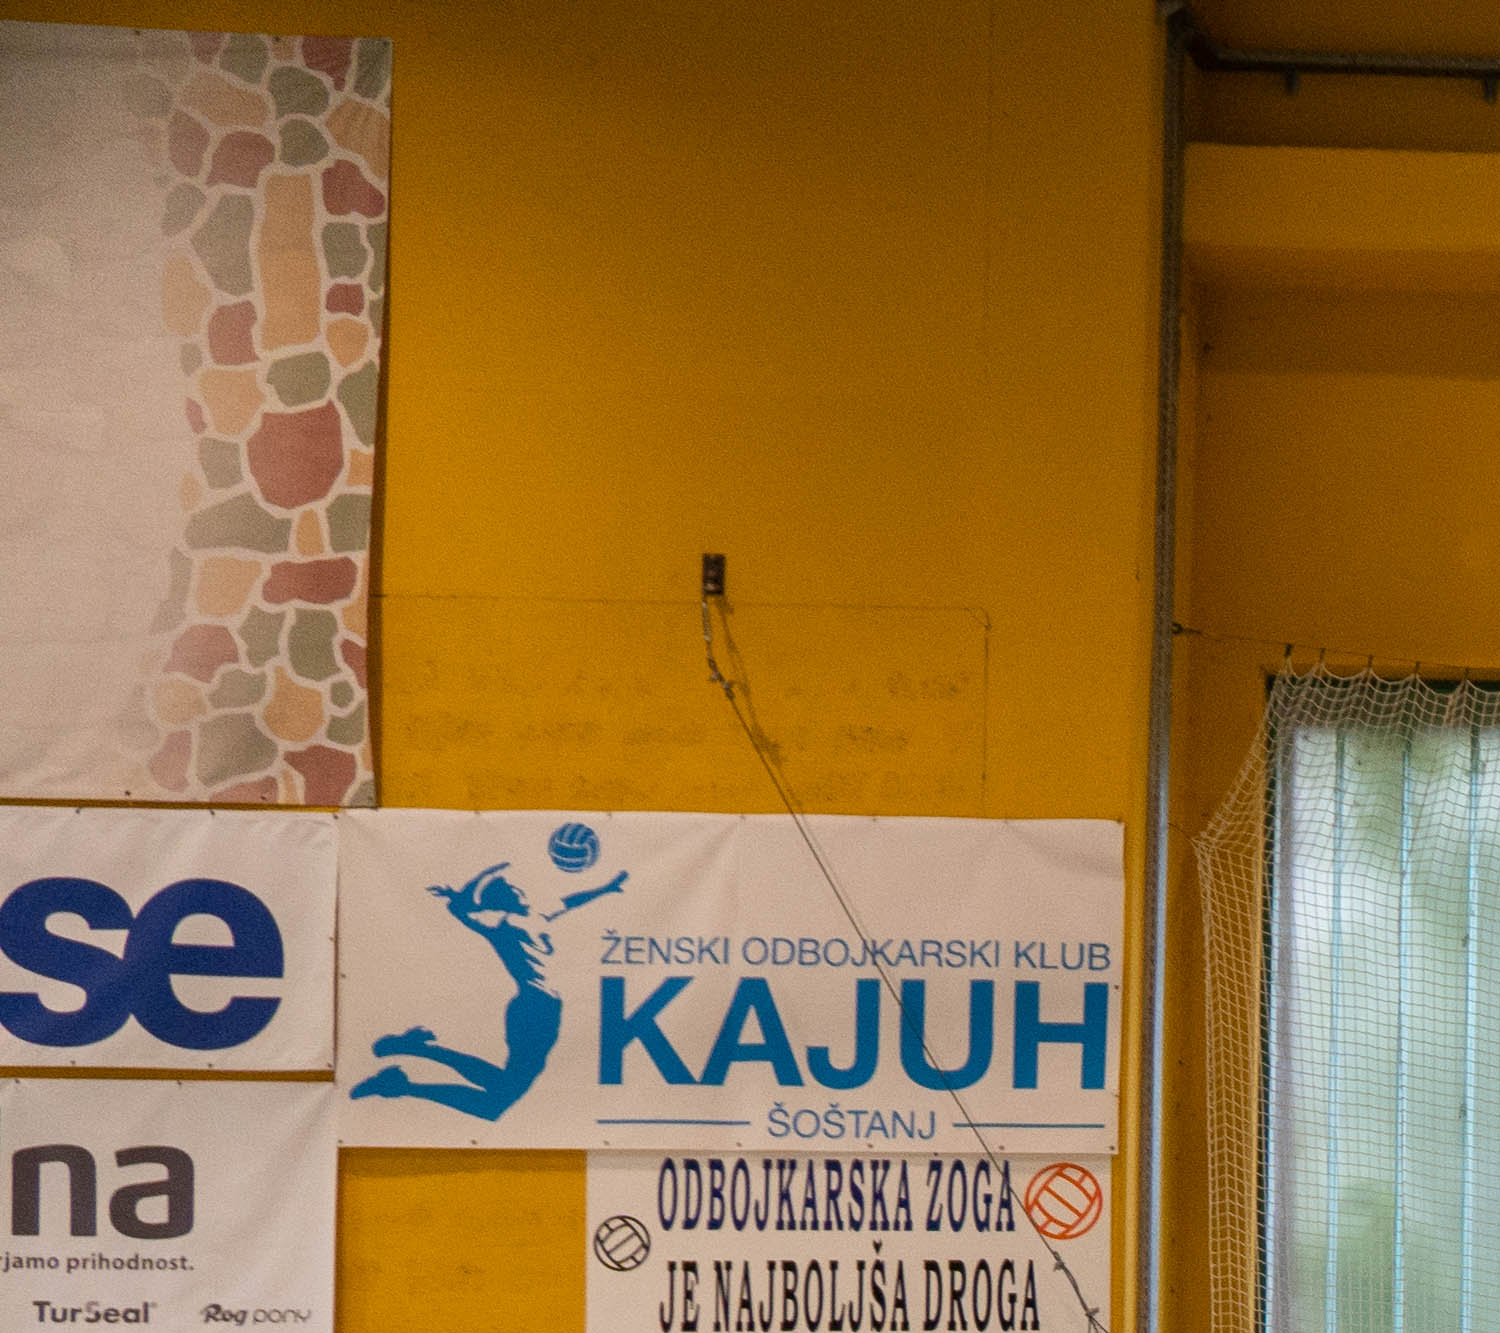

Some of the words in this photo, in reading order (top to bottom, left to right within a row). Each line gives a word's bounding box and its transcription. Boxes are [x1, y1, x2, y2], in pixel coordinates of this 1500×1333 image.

[600, 929, 731, 966] ŽENSKI
[741, 936, 1000, 969] ODBOJKARSKI
[1013, 940, 1112, 971] KLUB
[597, 975, 1110, 1091] KAJUH
[767, 1101, 937, 1140] ŠOŠTANJ
[10, 1143, 195, 1240] na
[658, 1156, 914, 1233] ODBOJKARSKA
[66, 1252, 196, 1275] prihodnost.
[659, 1259, 700, 1333] JE
[712, 1240, 911, 1333] NAJBOLJŠA
[922, 1258, 1041, 1333] DROGA
